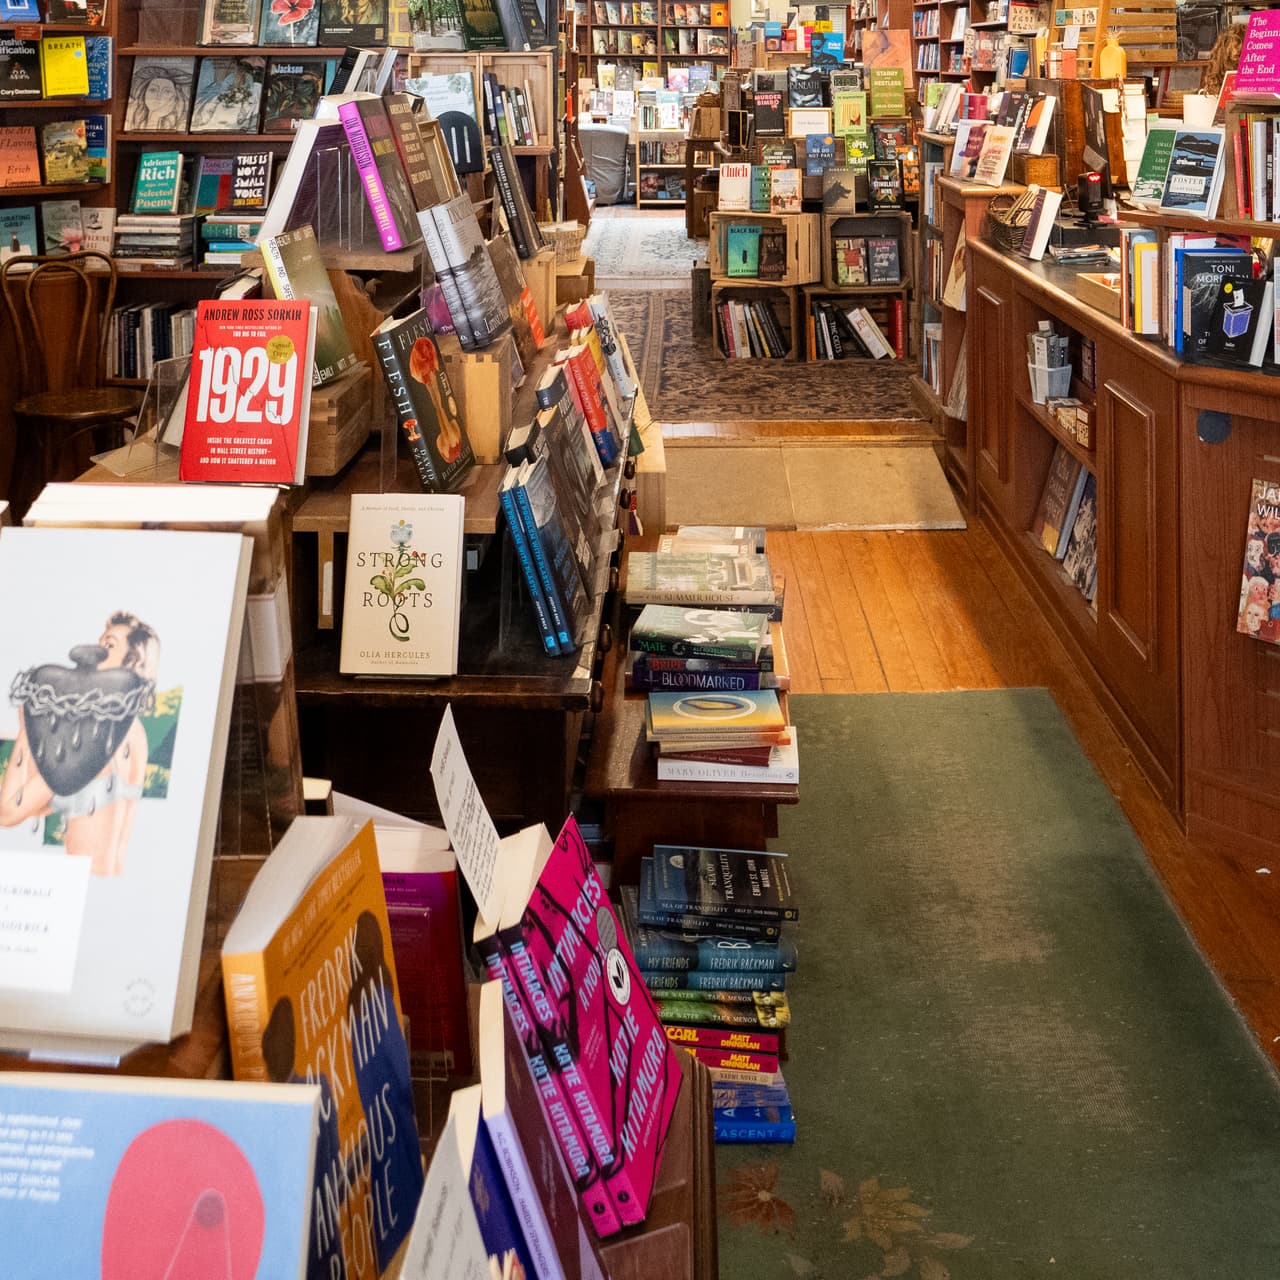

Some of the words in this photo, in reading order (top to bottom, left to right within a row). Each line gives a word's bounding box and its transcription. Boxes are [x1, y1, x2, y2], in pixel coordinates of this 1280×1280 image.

[1253, 17, 1268, 27] The
[48, 42, 82, 50] BREATH
[1247, 41, 1273, 51] Comes
[1244, 53, 1266, 63] After
[1241, 65, 1254, 75] the
[1257, 64, 1275, 74] End
[142, 158, 177, 167] Adrienne
[237, 155, 257, 166] THIS
[259, 154, 267, 164] IS
[141, 167, 175, 181] Rich
[237, 167, 255, 177] NOT
[257, 165, 265, 175] A
[721, 163, 748, 177] Clutch
[234, 178, 265, 188] SMALL
[139, 189, 173, 198] Selected
[235, 188, 263, 198] VOICE
[136, 198, 173, 208] Poems
[1210, 265, 1235, 273] TONI
[204, 308, 239, 321] ANDREW
[242, 309, 265, 320] ROSS
[268, 309, 302, 320] SORKIN
[378, 339, 412, 416] FLESH
[196, 346, 298, 426] 1929
[356, 551, 443, 568] STRONG
[362, 592, 433, 609] ROOTS
[640, 641, 667, 652] MATE
[359, 650, 381, 659] OLIA
[383, 650, 431, 660] HERCULES
[662, 673, 745, 690] BLOODMARKED
[667, 767, 695, 777] MARY
[698, 769, 736, 777] OLIVER
[546, 872, 602, 999] INTIMACIES
[648, 957, 659, 967] MY
[661, 958, 690, 969] FRIENDS
[711, 958, 738, 970] FREDRIK
[740, 959, 775, 970] BACKMAN
[299, 922, 363, 1052] FREDRIK
[608, 1005, 641, 1087] KATIE
[620, 1026, 668, 1162] KITAMURA
